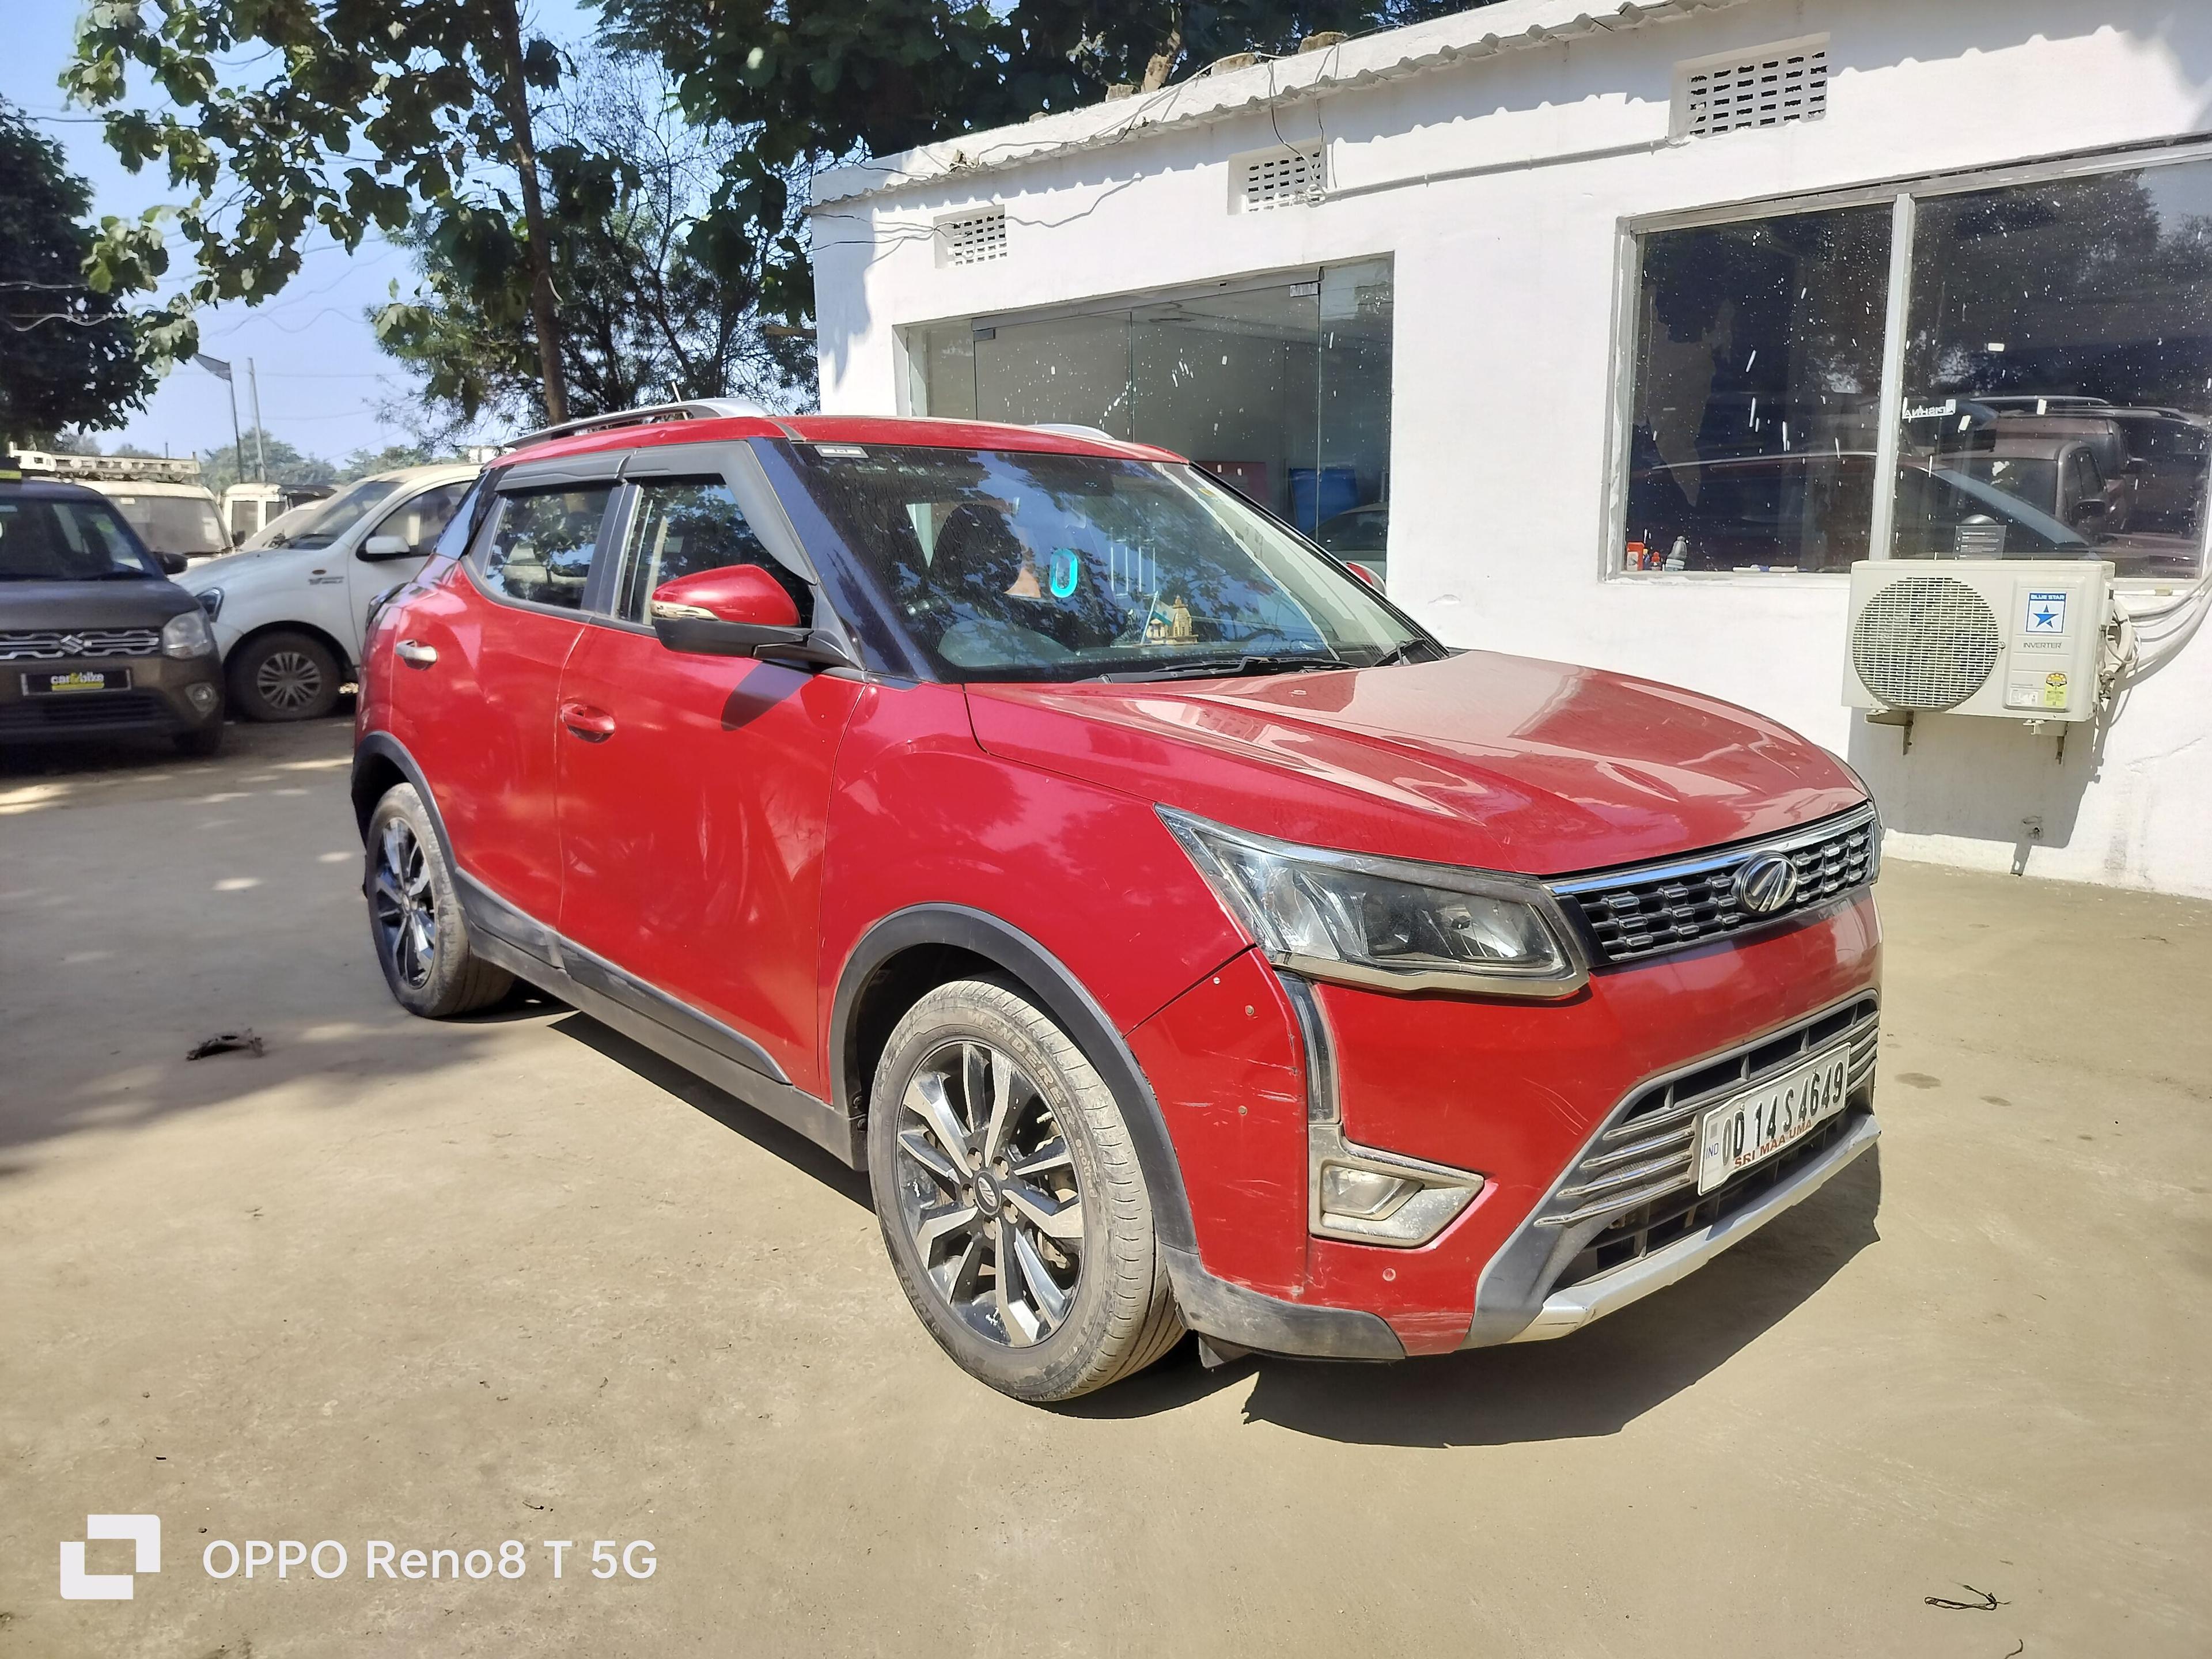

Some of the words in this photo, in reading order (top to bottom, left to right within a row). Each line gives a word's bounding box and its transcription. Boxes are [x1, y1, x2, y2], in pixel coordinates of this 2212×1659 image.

[1755, 1094, 1778, 1148] 14
[1782, 1087, 1794, 1133] S
[1797, 1060, 1843, 1122] 4649
[1706, 1142, 1719, 1160] IND
[1734, 1153, 1756, 1169] SRI
[1760, 1135, 1786, 1157] MAA
[1789, 1119, 1812, 1139] UMA
